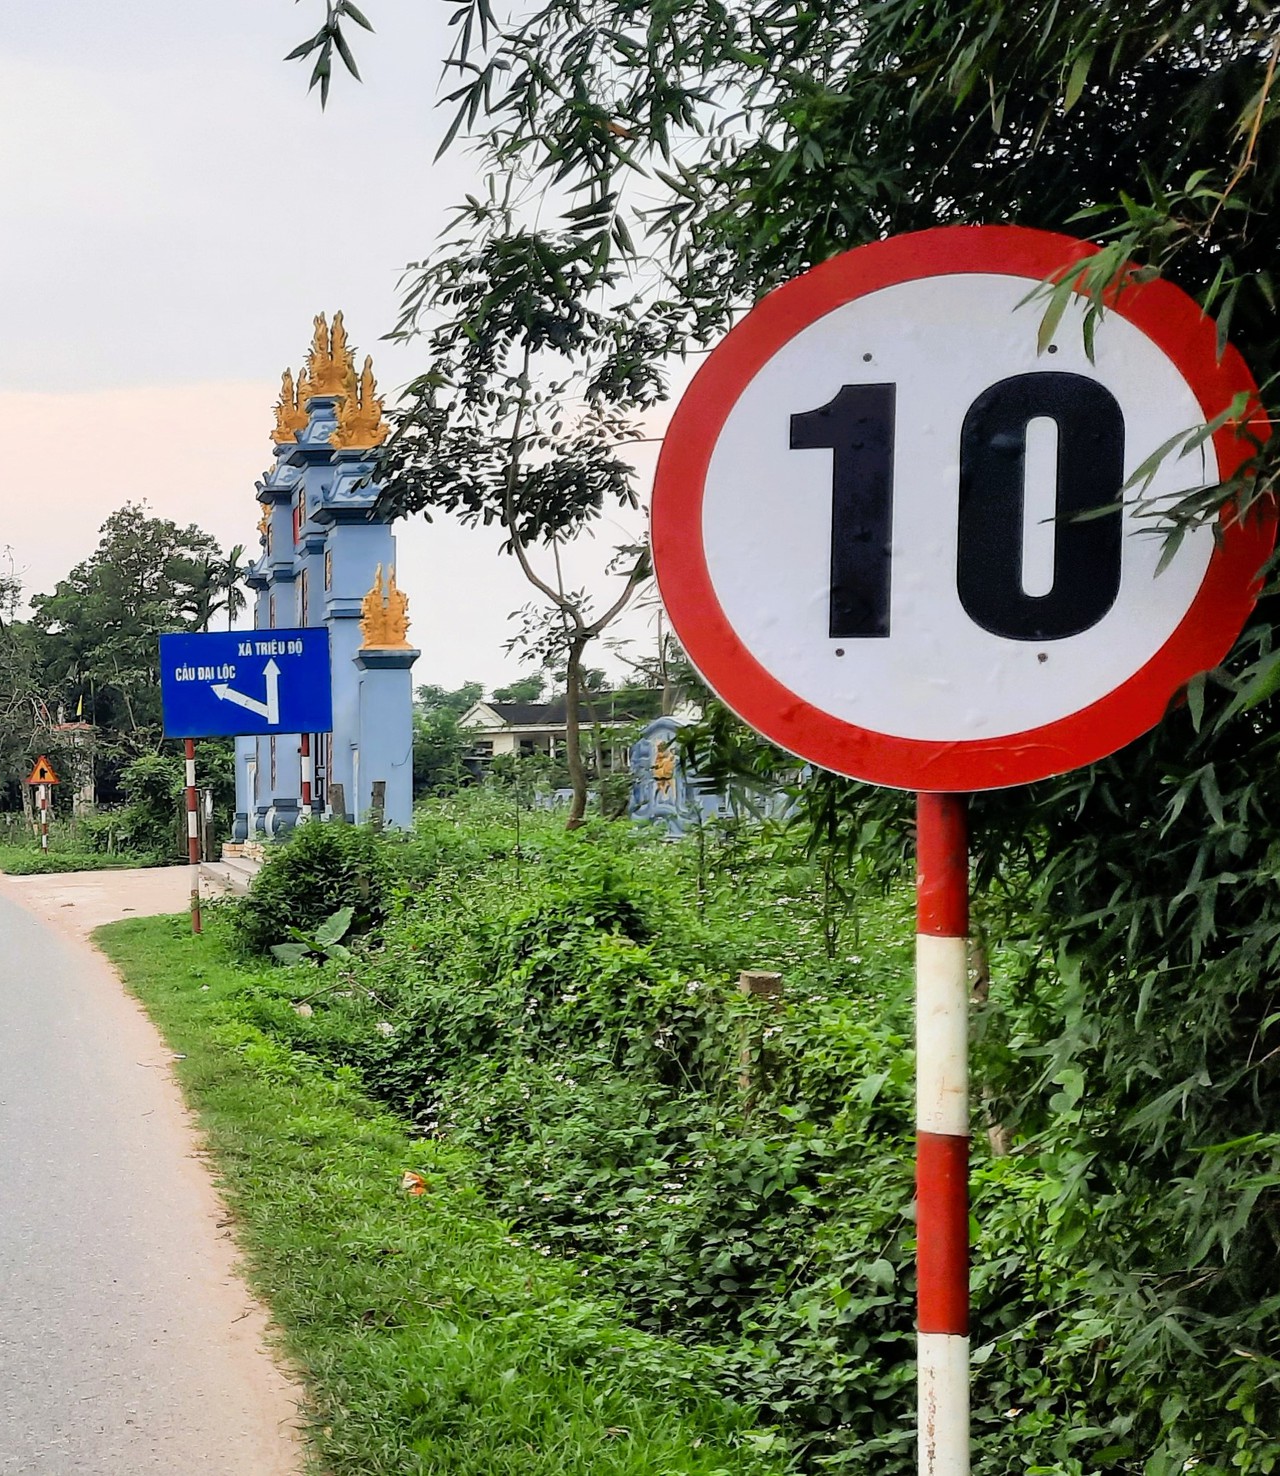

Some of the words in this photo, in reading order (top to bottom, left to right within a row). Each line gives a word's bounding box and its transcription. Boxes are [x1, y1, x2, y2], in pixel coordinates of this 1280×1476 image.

[789, 371, 1126, 642] 10
[238, 639, 253, 656] XÃ
[255, 638, 286, 658] TRIỆU
[287, 637, 303, 657] ĐỘ
[197, 666, 215, 683] ĐẠI
[217, 663, 236, 682] LỘC
